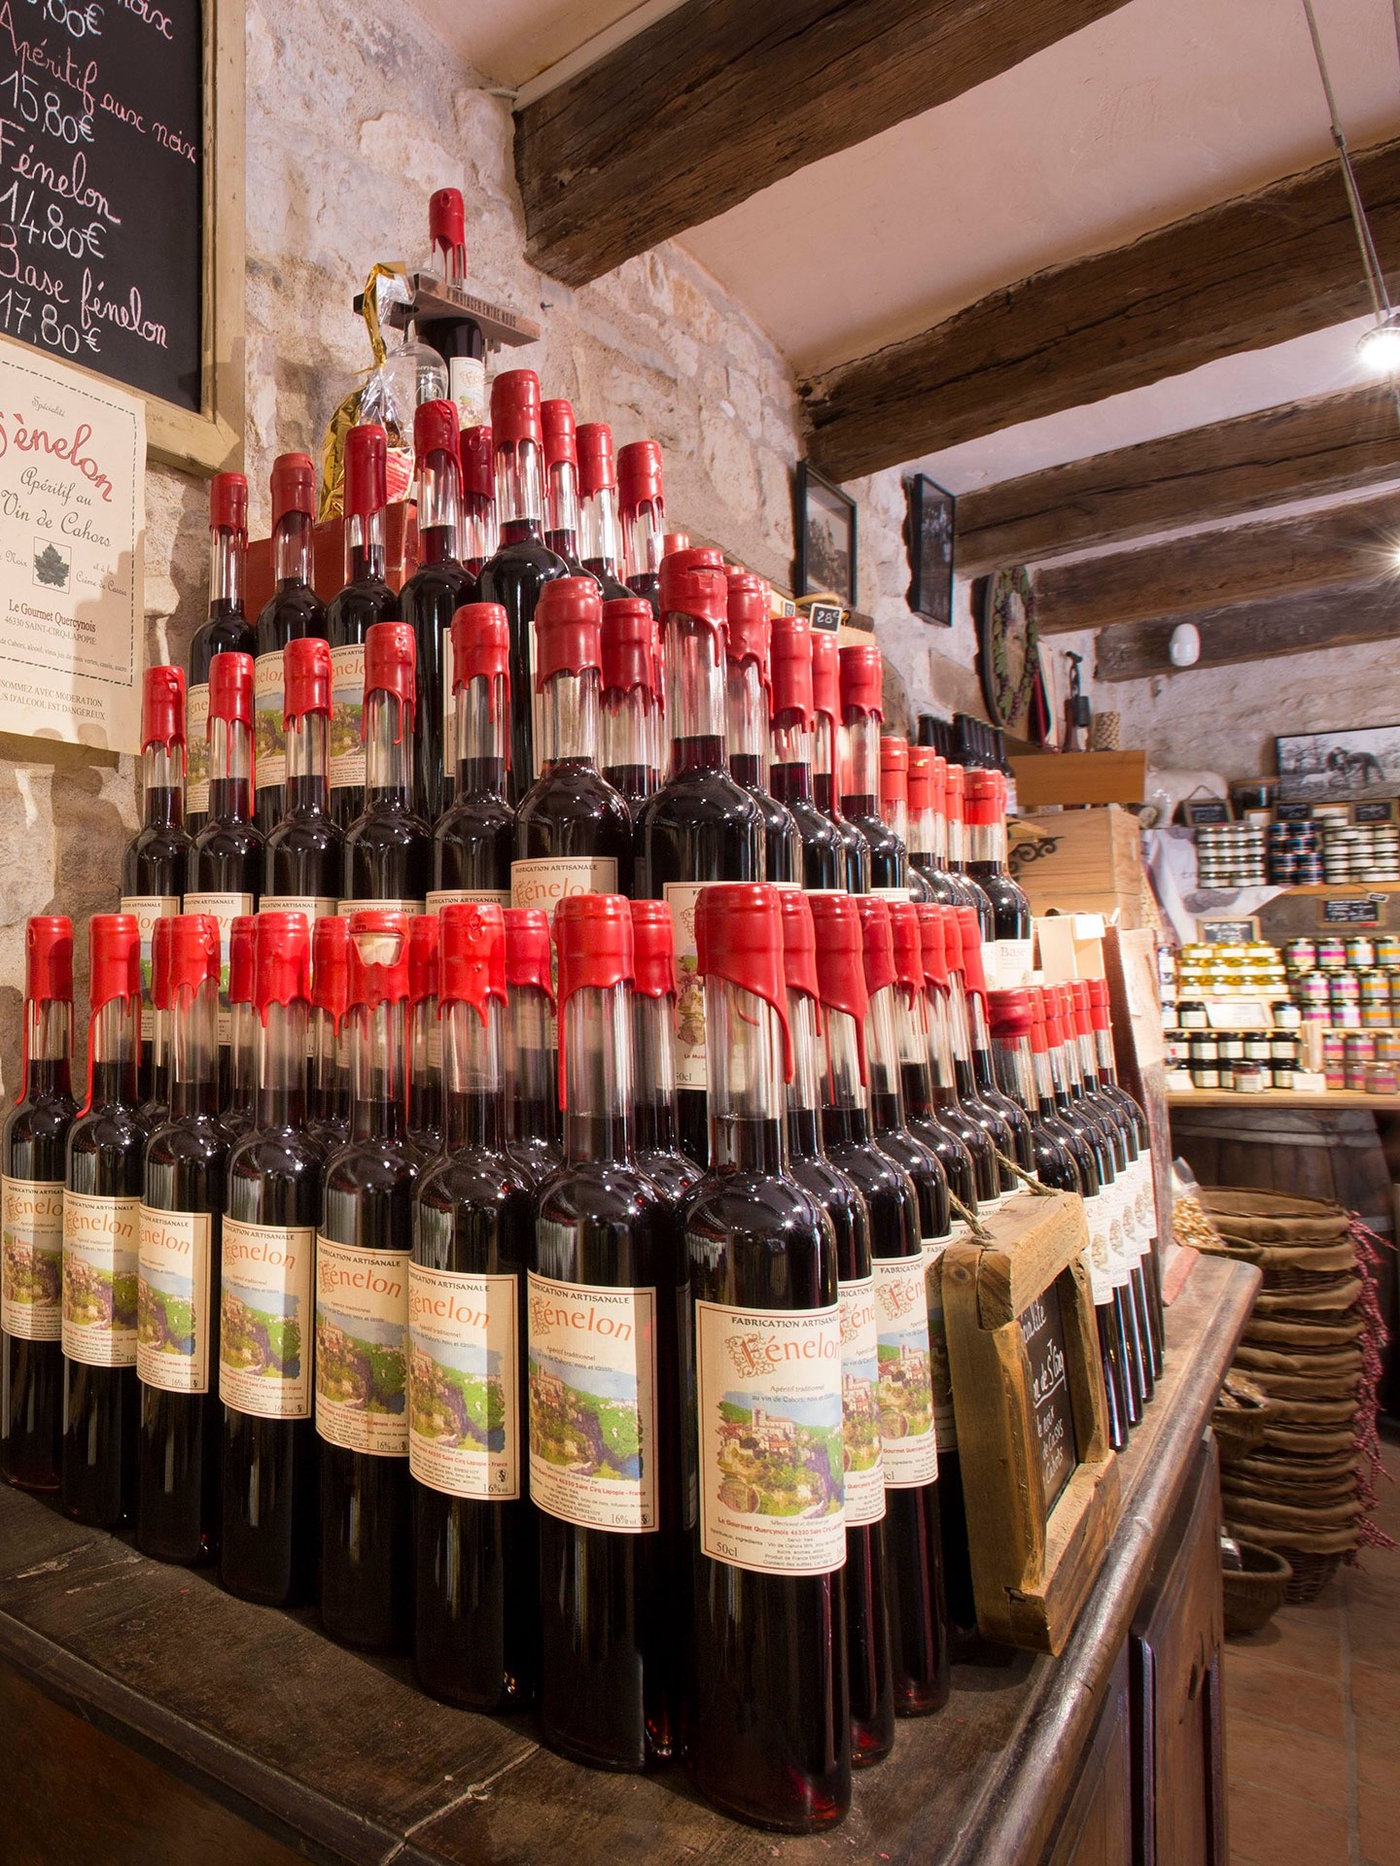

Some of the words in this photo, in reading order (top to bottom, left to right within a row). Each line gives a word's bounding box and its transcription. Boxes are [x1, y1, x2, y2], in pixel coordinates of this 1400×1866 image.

[100, 93, 147, 134] aux
[152, 122, 197, 164] noix
[20, 466, 76, 507] Apéritif
[76, 494, 94, 507] au
[0, 489, 31, 522] Vin
[36, 509, 53, 529] de
[60, 511, 112, 547] Cahors
[5, 549, 28, 568] Noix
[9, 598, 20, 612] Le
[20, 602, 54, 622] Gourmet
[54, 611, 97, 633] Quercynois
[4, 614, 24, 628] 46330
[24, 619, 97, 646] SAINT-CIRQ-LAPOPIE
[34, 686, 56, 700] AVEC
[55, 691, 103, 707] MODERATION
[10, 693, 47, 709] D'ALCOOL
[48, 701, 61, 711] EST
[61, 703, 106, 721] DANGEREUX
[551, 864, 598, 872] ARTISANALE
[64, 1208, 134, 1239] Fénelon
[152, 1217, 189, 1228] ARTISANALE
[250, 1231, 295, 1241] ARTISANALE
[223, 1235, 297, 1270] Fénelon
[353, 1257, 401, 1268] ARTISANALE
[319, 1260, 402, 1299] Fénelon
[438, 1280, 490, 1293] ARTISANALE
[570, 1292, 630, 1305] ARTISANALE
[530, 1298, 632, 1342] Fénelon
[731, 1316, 800, 1329] FABRICATION
[724, 1331, 840, 1379] Fénelon
[770, 1384, 795, 1393] Apéritif
[376, 1440, 391, 1450] 16%
[611, 1512, 628, 1525] 16%
[724, 1519, 753, 1531] Gourmet
[753, 1525, 789, 1536] Quercynois
[716, 1541, 738, 1557] 50cl
